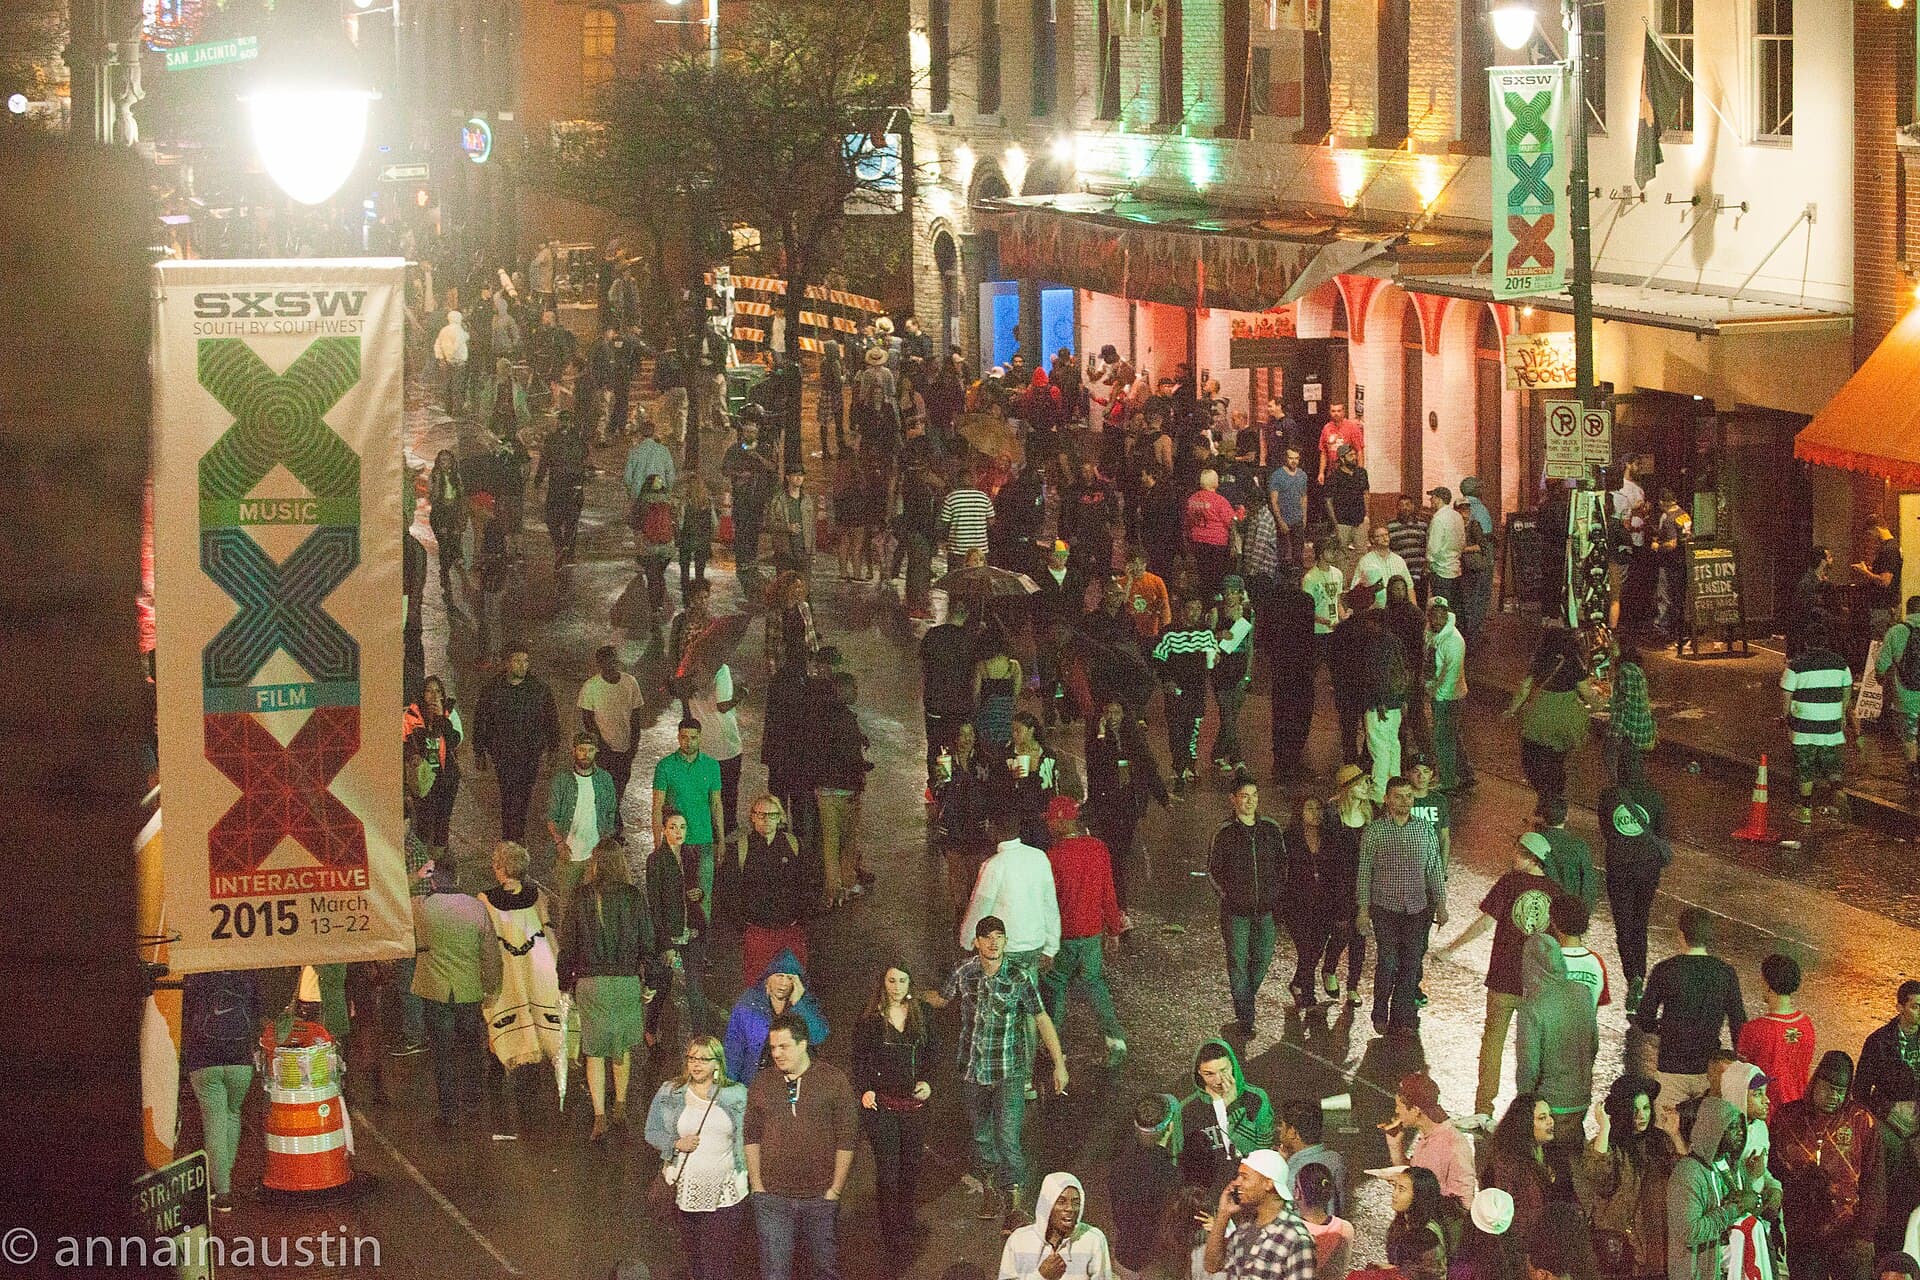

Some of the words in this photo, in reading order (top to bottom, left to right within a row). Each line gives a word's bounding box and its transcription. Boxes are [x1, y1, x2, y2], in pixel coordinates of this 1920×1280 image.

[165, 51, 189, 67] SAN
[193, 44, 237, 63] JACINTO
[1502, 75, 1552, 86] SXSW
[1504, 277, 1531, 290] 2015
[193, 291, 368, 319] SXSW
[193, 320, 245, 336] SOUTH
[250, 320, 269, 335] BY
[273, 319, 366, 334] SOUTHWEST
[239, 502, 319, 521] MUSIC
[1714, 561, 1736, 577] DRY
[1698, 580, 1733, 594] INSIDE
[256, 685, 306, 708] FILM
[214, 867, 368, 896] INTERACTIVE
[310, 895, 369, 914] March
[209, 899, 299, 941] 2015
